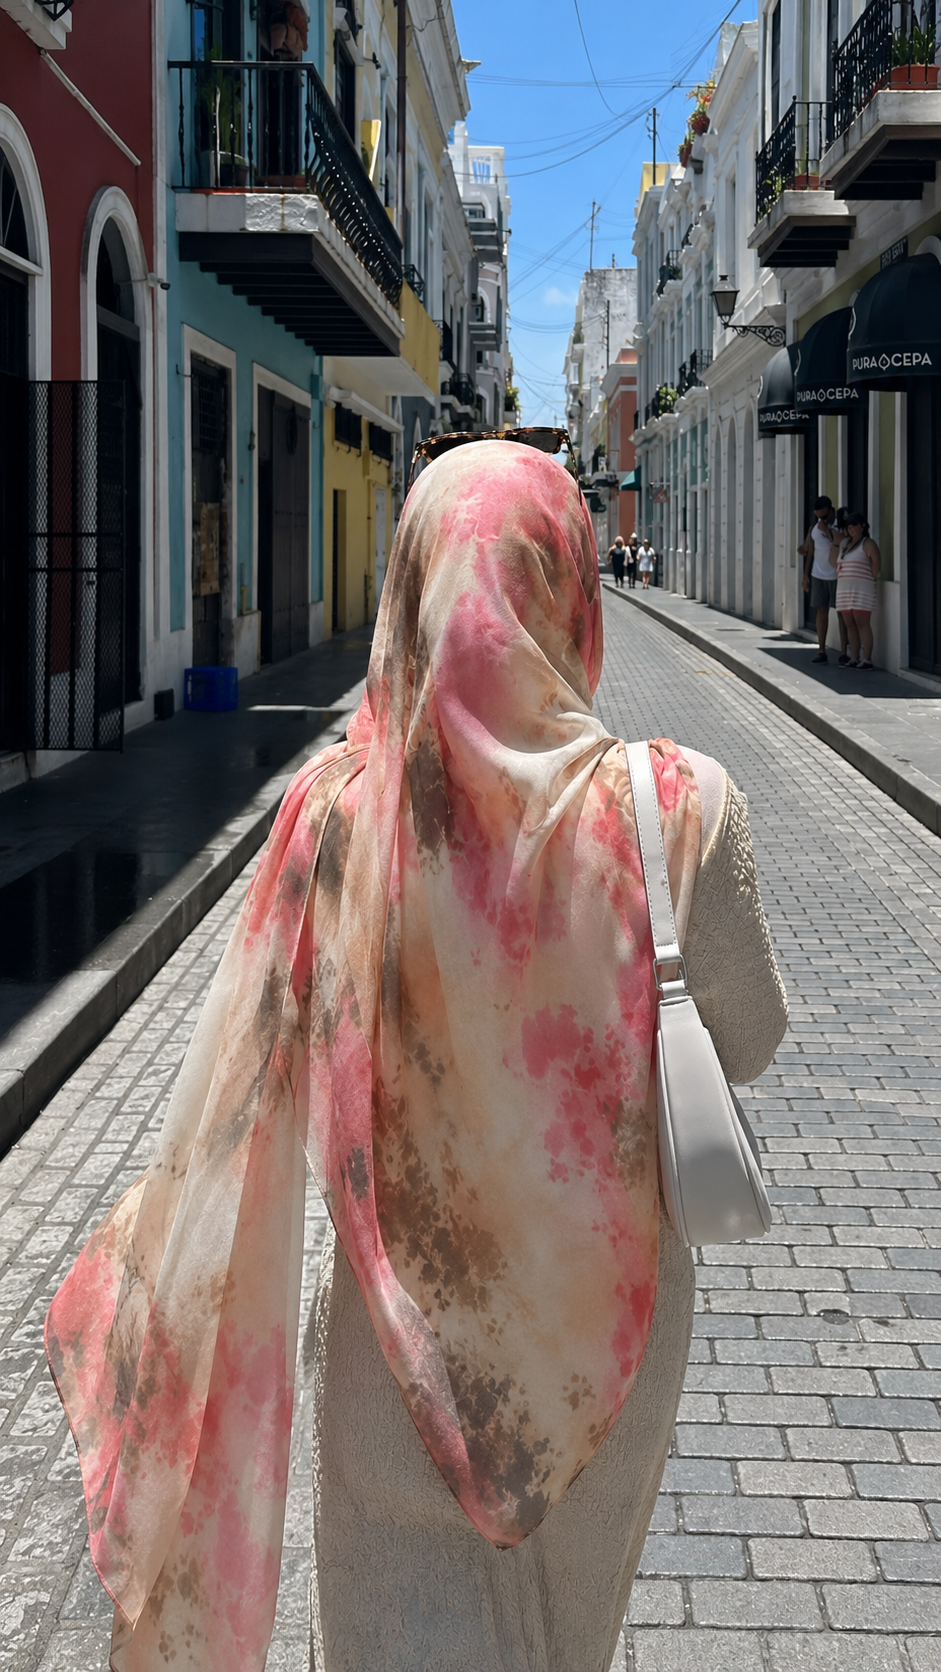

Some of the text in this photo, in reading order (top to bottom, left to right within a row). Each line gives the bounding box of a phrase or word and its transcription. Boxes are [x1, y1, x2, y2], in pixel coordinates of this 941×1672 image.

[852, 352, 932, 371] PURA CEPA
[796, 387, 859, 402] PURA CEPA
